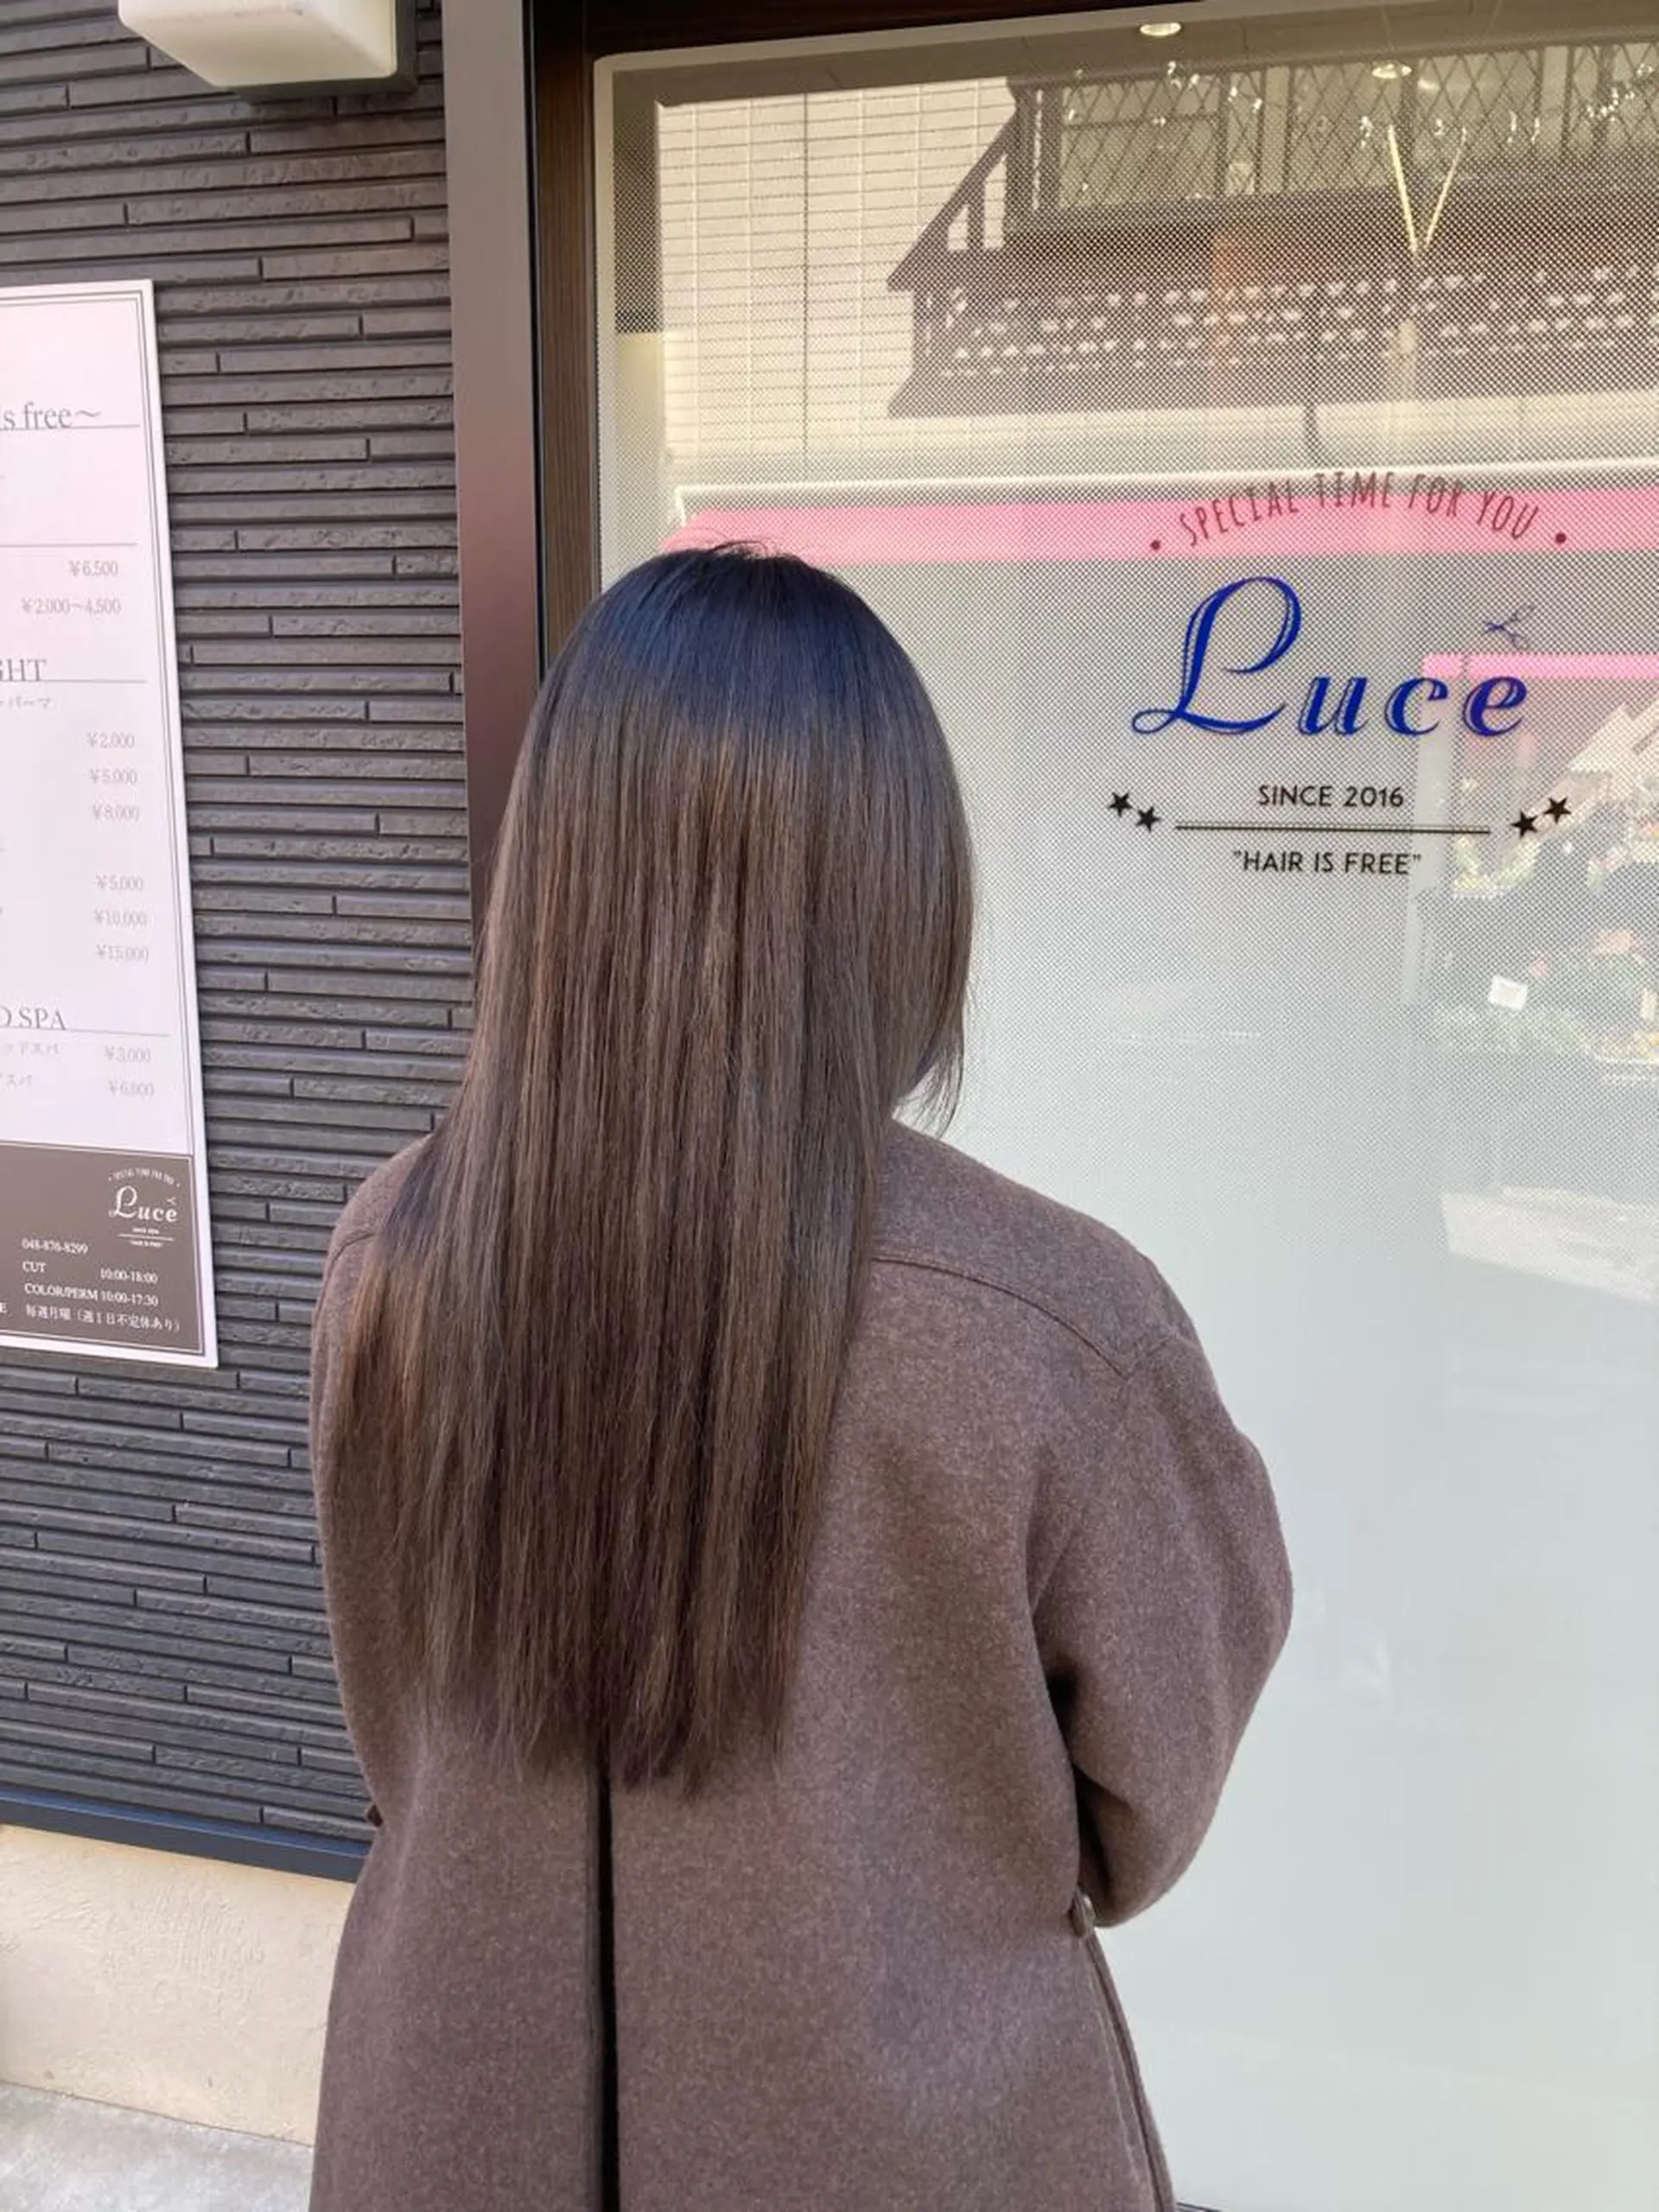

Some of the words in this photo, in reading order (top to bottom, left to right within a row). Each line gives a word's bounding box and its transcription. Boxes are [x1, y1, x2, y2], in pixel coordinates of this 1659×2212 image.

[1180, 480, 1299, 547] SPECIAL
[1315, 471, 1395, 508] TIME
[1408, 474, 1463, 517] FOR
[1476, 489, 1539, 539] YOU
[1131, 576, 1528, 737] Luce
[0, 658, 47, 681] HT
[1257, 785, 1333, 807] SINCE
[1343, 786, 1405, 807] 2016
[1233, 850, 1304, 873] "HAIR
[1314, 852, 1333, 873] IS
[1345, 852, 1422, 874] FREE"
[19, 1007, 67, 1031] SPA
[108, 1185, 178, 1222] Luce
[22, 1261, 48, 1273] CUT
